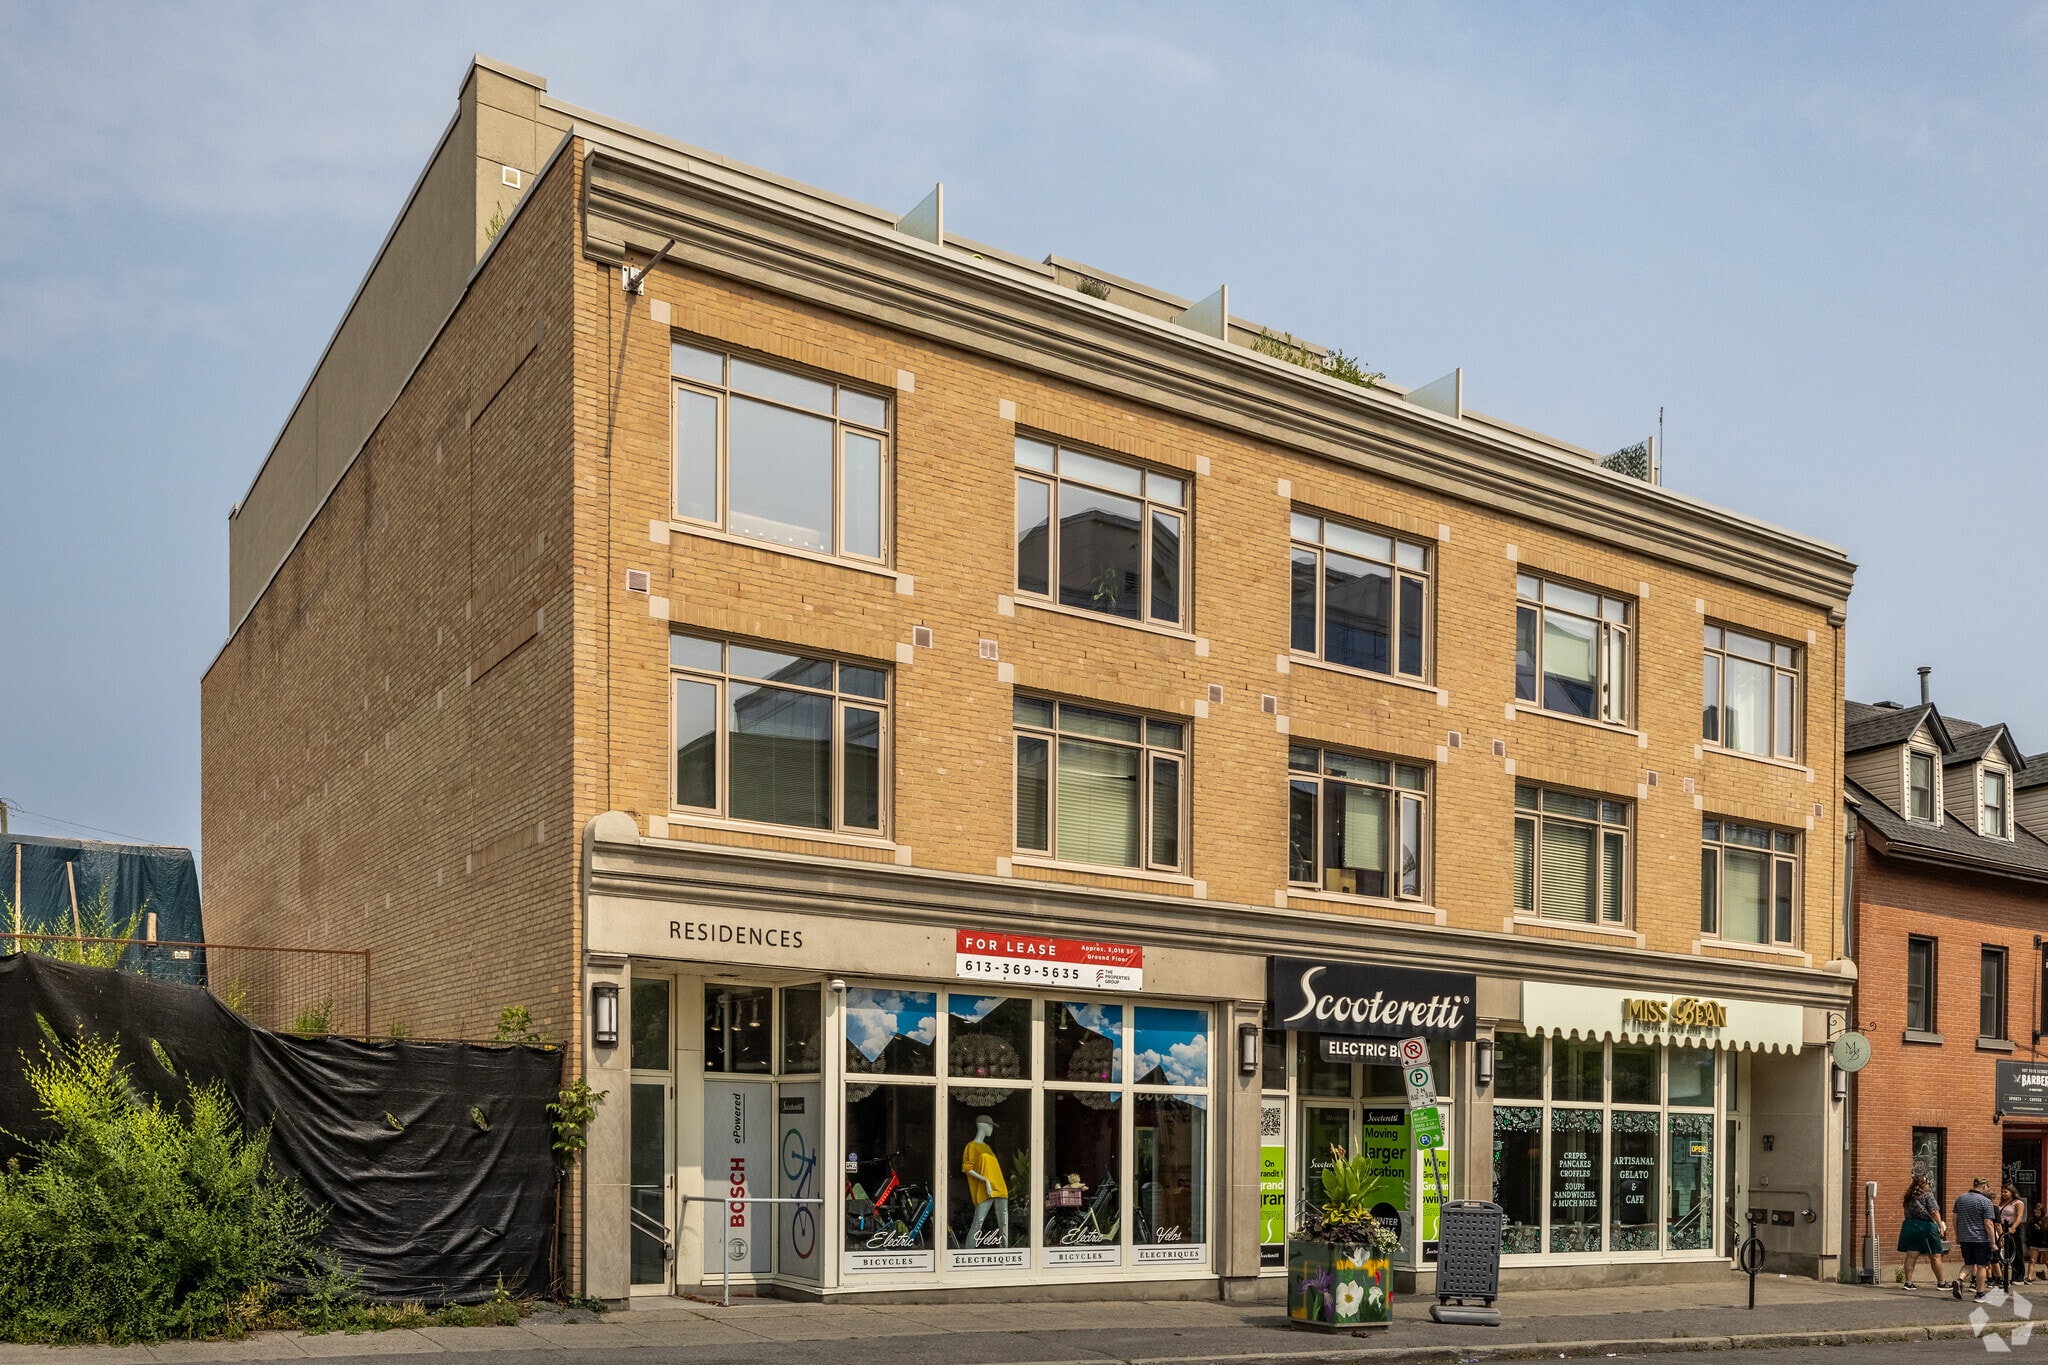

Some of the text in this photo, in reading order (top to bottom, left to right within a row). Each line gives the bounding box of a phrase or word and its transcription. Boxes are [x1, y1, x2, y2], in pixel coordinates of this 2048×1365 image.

[669, 920, 804, 949] RESIDENCES
[965, 937, 1057, 956] FOR LEASE
[1081, 945, 1106, 953] Approx.
[965, 960, 1079, 980] 613-369-5635
[1622, 997, 1727, 1027] MISS BEAN
[1328, 1041, 1387, 1057] ELECTRIC
[733, 1092, 742, 1144] ePowered
[1365, 1127, 1398, 1141] Moving
[1364, 1141, 1406, 1165] larger
[1563, 1152, 1587, 1160] CREPES
[1264, 1159, 1275, 1168] On
[1423, 1157, 1447, 1168] W're
[1559, 1160, 1592, 1168] PANCAKES
[1613, 1156, 1655, 1166] ARTISANAL
[1260, 1169, 1280, 1178] randit
[1369, 1165, 1405, 1178] ocation
[1560, 1170, 1591, 1178] CROFFLES
[1619, 1170, 1649, 1179] GELATO
[1260, 1179, 1284, 1192] rand
[1564, 1182, 1586, 1190] SOUPS
[1631, 1182, 1637, 1191] &
[730, 1157, 745, 1227] BOSCH
[1554, 1191, 1596, 1199] SANDWICHES
[1260, 1193, 1285, 1208] ran
[1558, 1199, 1578, 1207] MUCH
[1625, 1195, 1645, 1204] CAFE
[866, 1229, 915, 1249] Electric
[1061, 1226, 1104, 1245] Electric
[955, 1255, 1023, 1265] ÉLECTRIQUES
[1058, 1253, 1103, 1261] BICYCLES
[1139, 1251, 1200, 1259] ÉLECTRIQUES
[863, 1257, 914, 1266] BICYCLES
